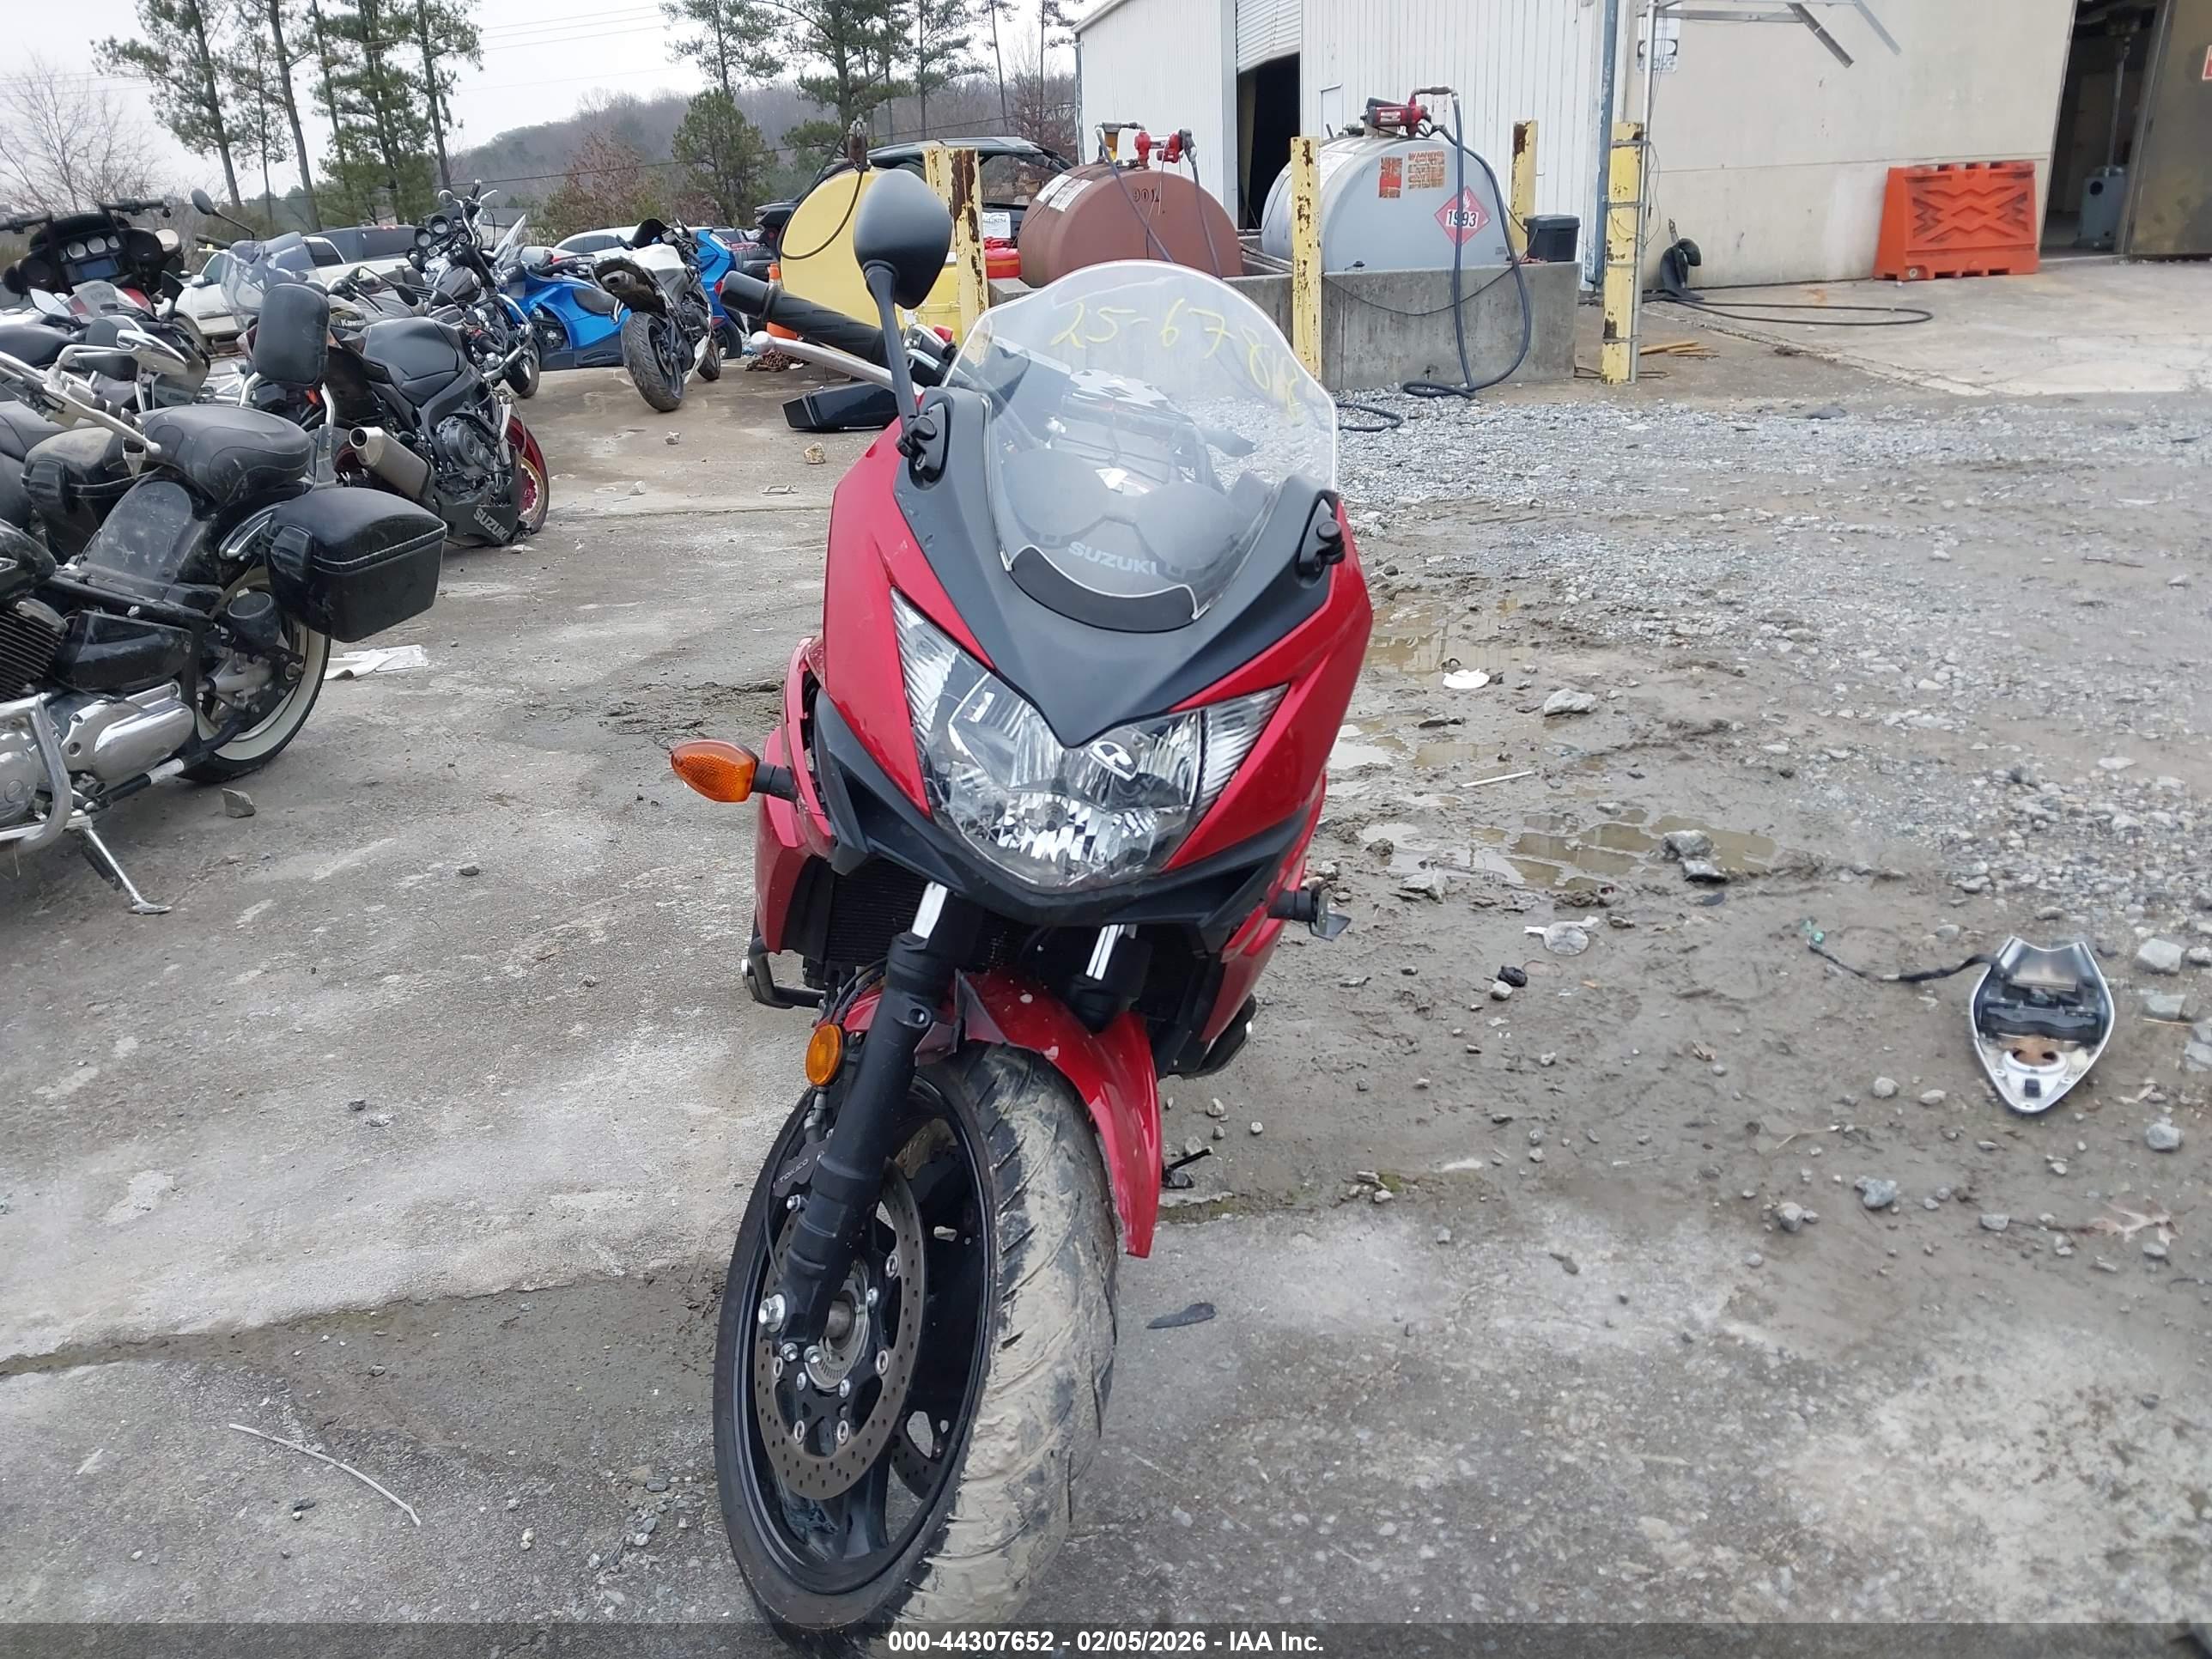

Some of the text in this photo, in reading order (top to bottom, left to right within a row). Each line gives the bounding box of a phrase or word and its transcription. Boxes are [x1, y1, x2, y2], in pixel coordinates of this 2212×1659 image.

[1448, 210, 1477, 227] 1993
[473, 507, 511, 542] SUZUKI
[1068, 541, 1157, 575] SUZUKI
